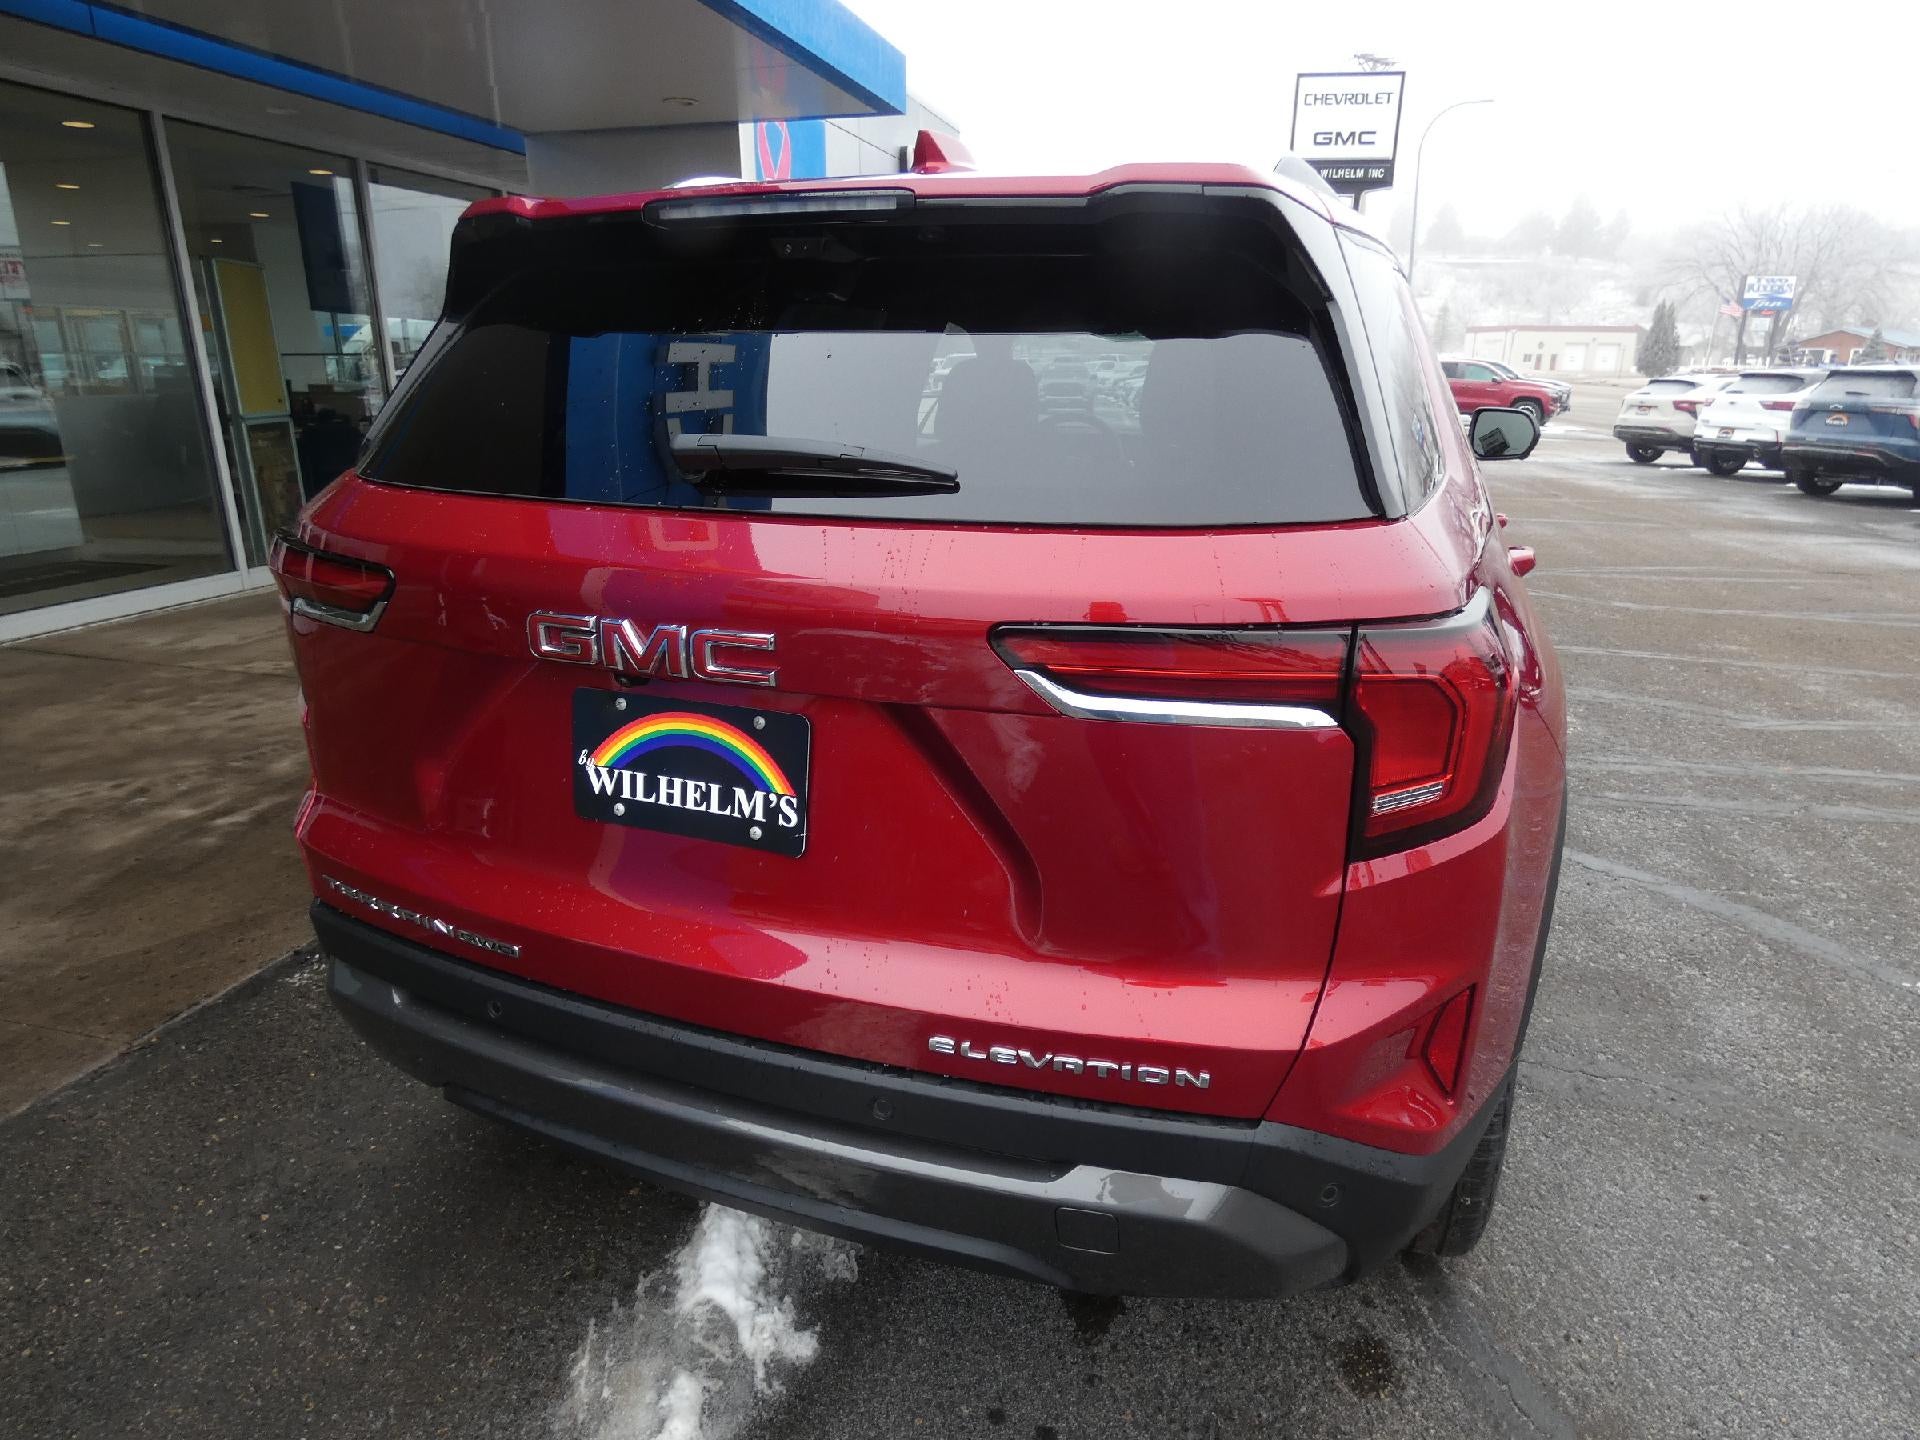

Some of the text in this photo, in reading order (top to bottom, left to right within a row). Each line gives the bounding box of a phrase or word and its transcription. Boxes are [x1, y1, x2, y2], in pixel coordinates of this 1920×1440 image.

[1304, 92, 1394, 106] CHEVROLET
[1313, 131, 1376, 146] GMC
[1320, 167, 1385, 179] WILHELM INC
[526, 609, 777, 687] GMC
[587, 765, 799, 828] WILHELM'S
[928, 1034, 1211, 1090] ELEVATION
